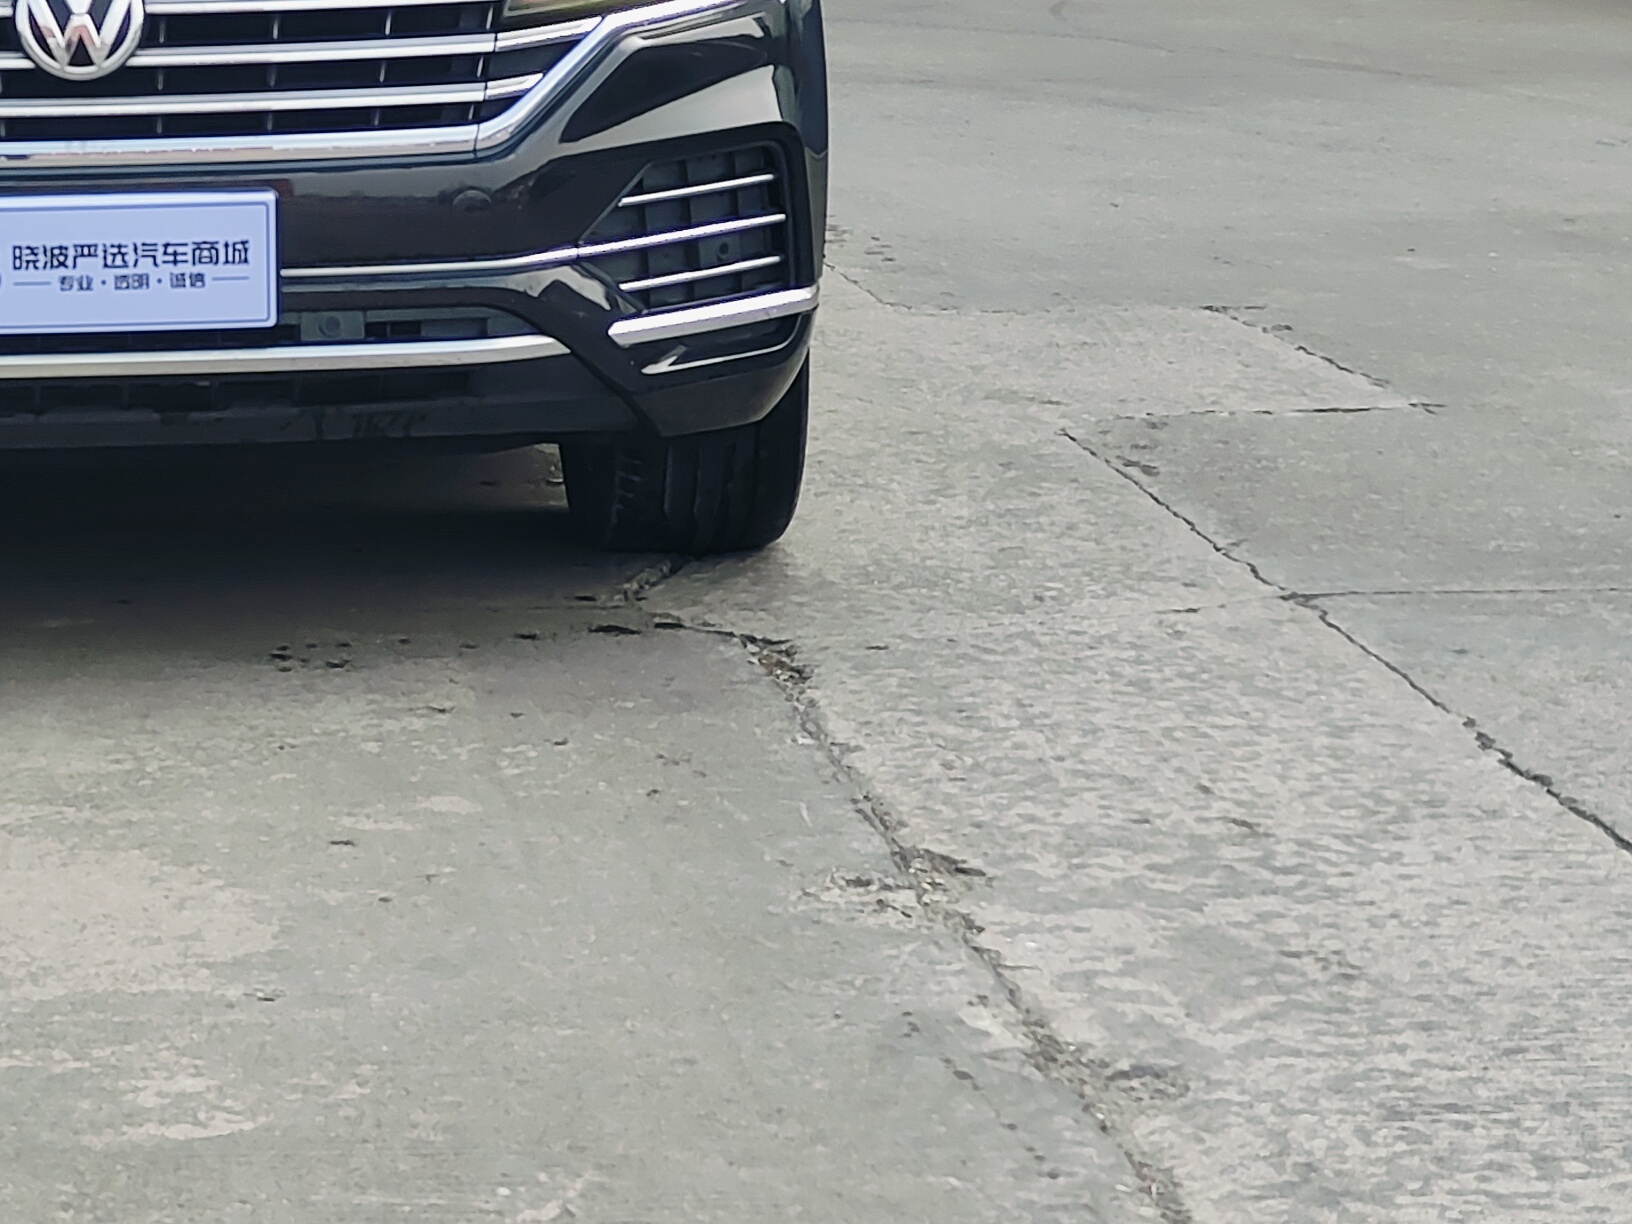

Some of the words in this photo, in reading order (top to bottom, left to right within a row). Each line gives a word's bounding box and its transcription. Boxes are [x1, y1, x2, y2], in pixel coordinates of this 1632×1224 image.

[12, 240, 250, 270] 晓波严选汽车商城
